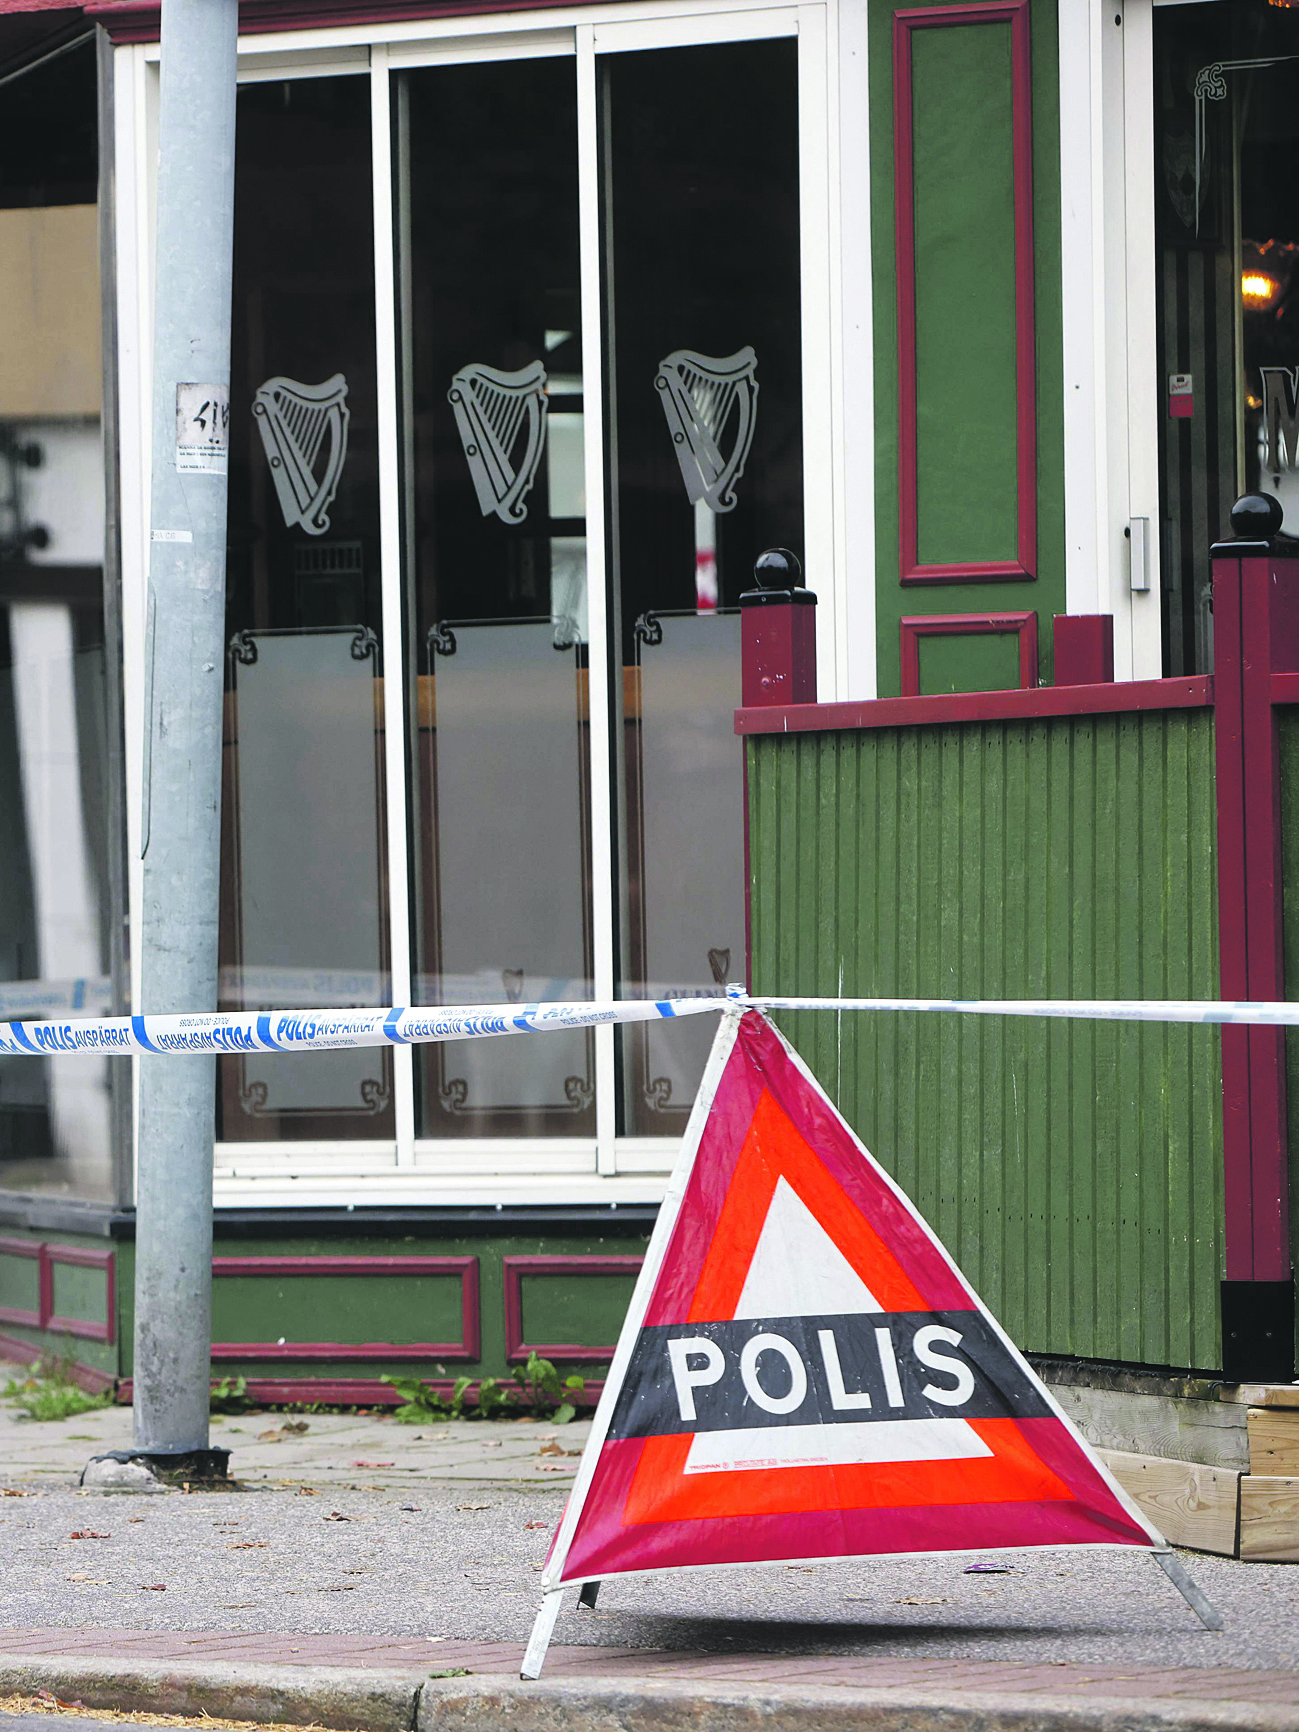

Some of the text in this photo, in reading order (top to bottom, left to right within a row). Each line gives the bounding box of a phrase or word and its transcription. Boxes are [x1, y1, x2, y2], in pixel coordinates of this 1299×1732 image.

[277, 1014, 383, 1042] POLIS AVSPÄRRAT
[561, 1015, 579, 1026] POLICE
[599, 1010, 618, 1021] CROSS
[34, 1025, 130, 1051] POLIS AVSPÄRRAT
[156, 1026, 260, 1052] POLIS AVSPÄRRAT
[666, 1324, 977, 1422] POLIS
